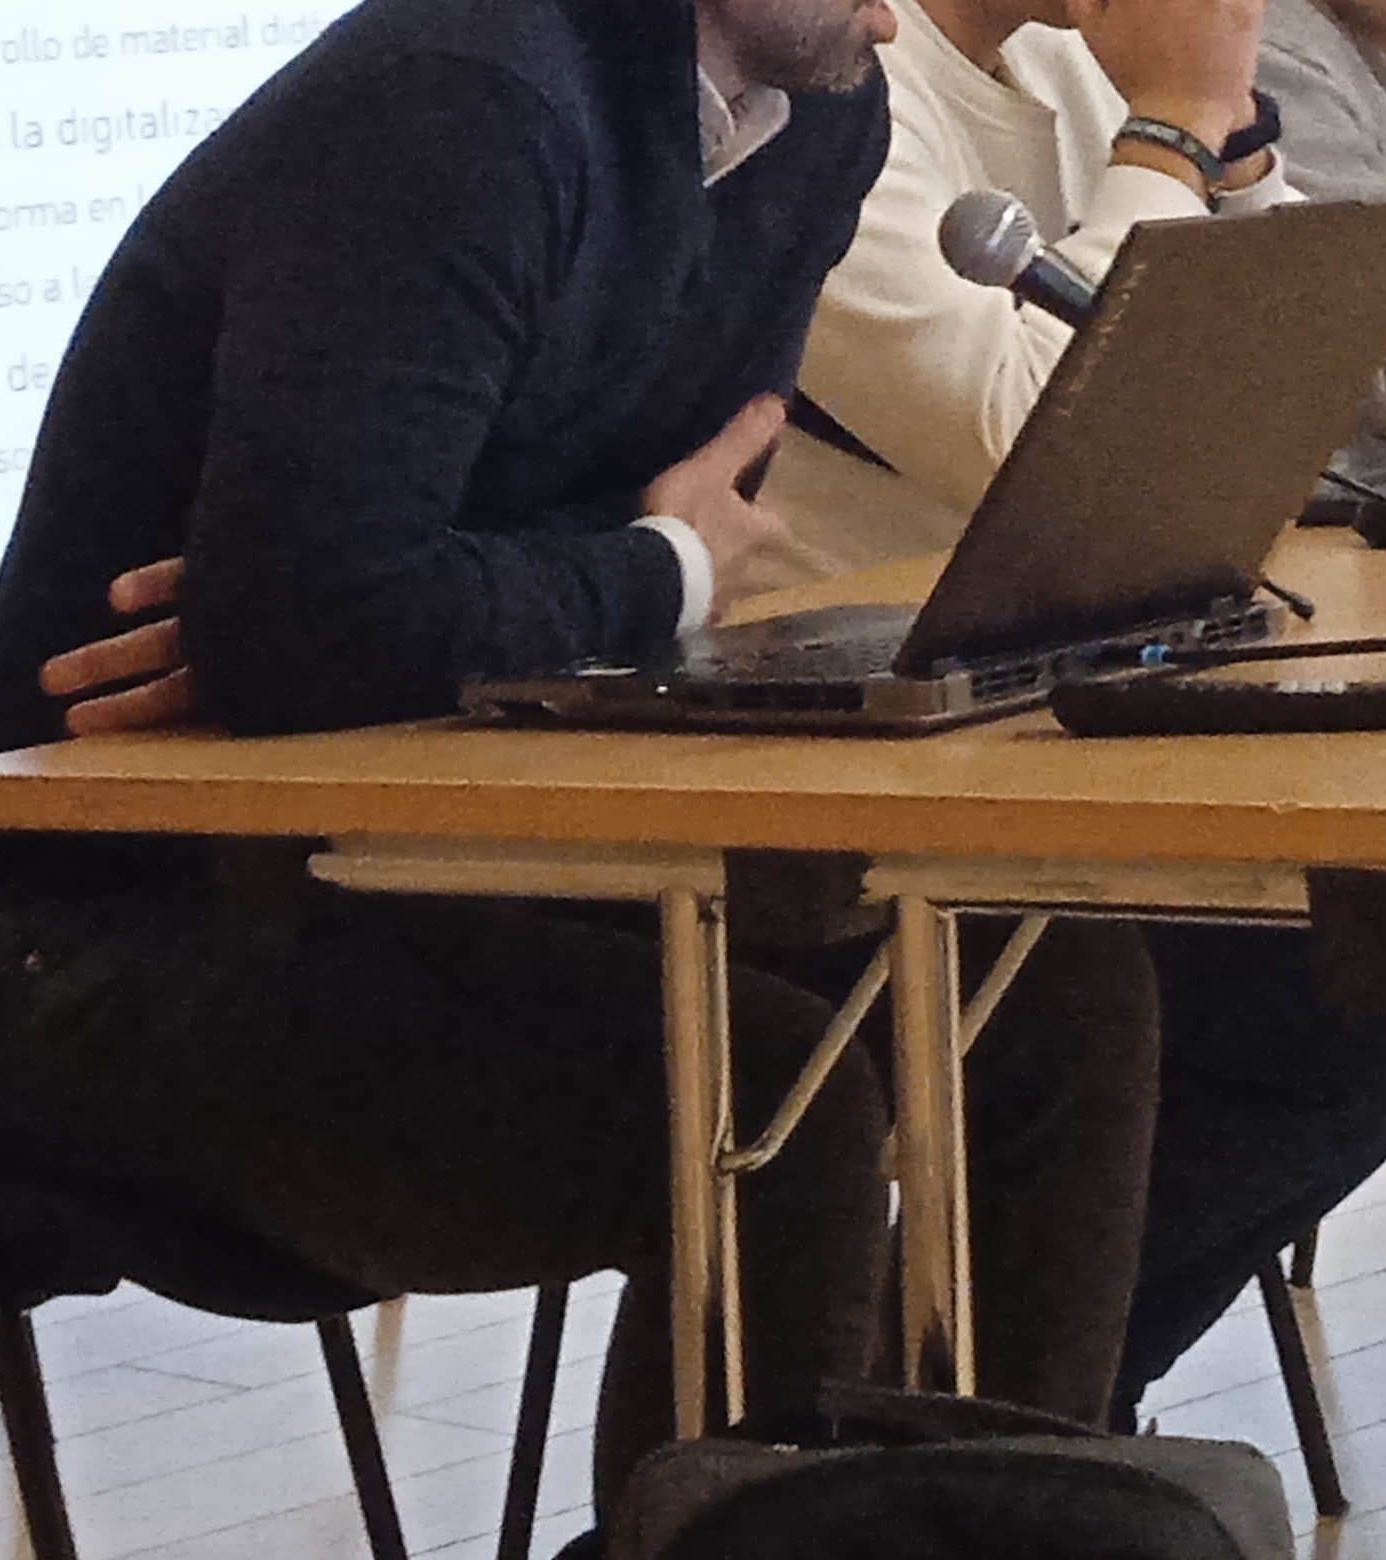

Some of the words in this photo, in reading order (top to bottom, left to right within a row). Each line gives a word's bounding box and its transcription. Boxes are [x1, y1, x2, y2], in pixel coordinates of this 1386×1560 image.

[74, 25, 109, 61] de
[120, 16, 250, 56] material
[10, 110, 43, 150] la
[57, 100, 239, 154] digitaliza
[89, 195, 126, 225] en
[43, 278, 62, 303] a
